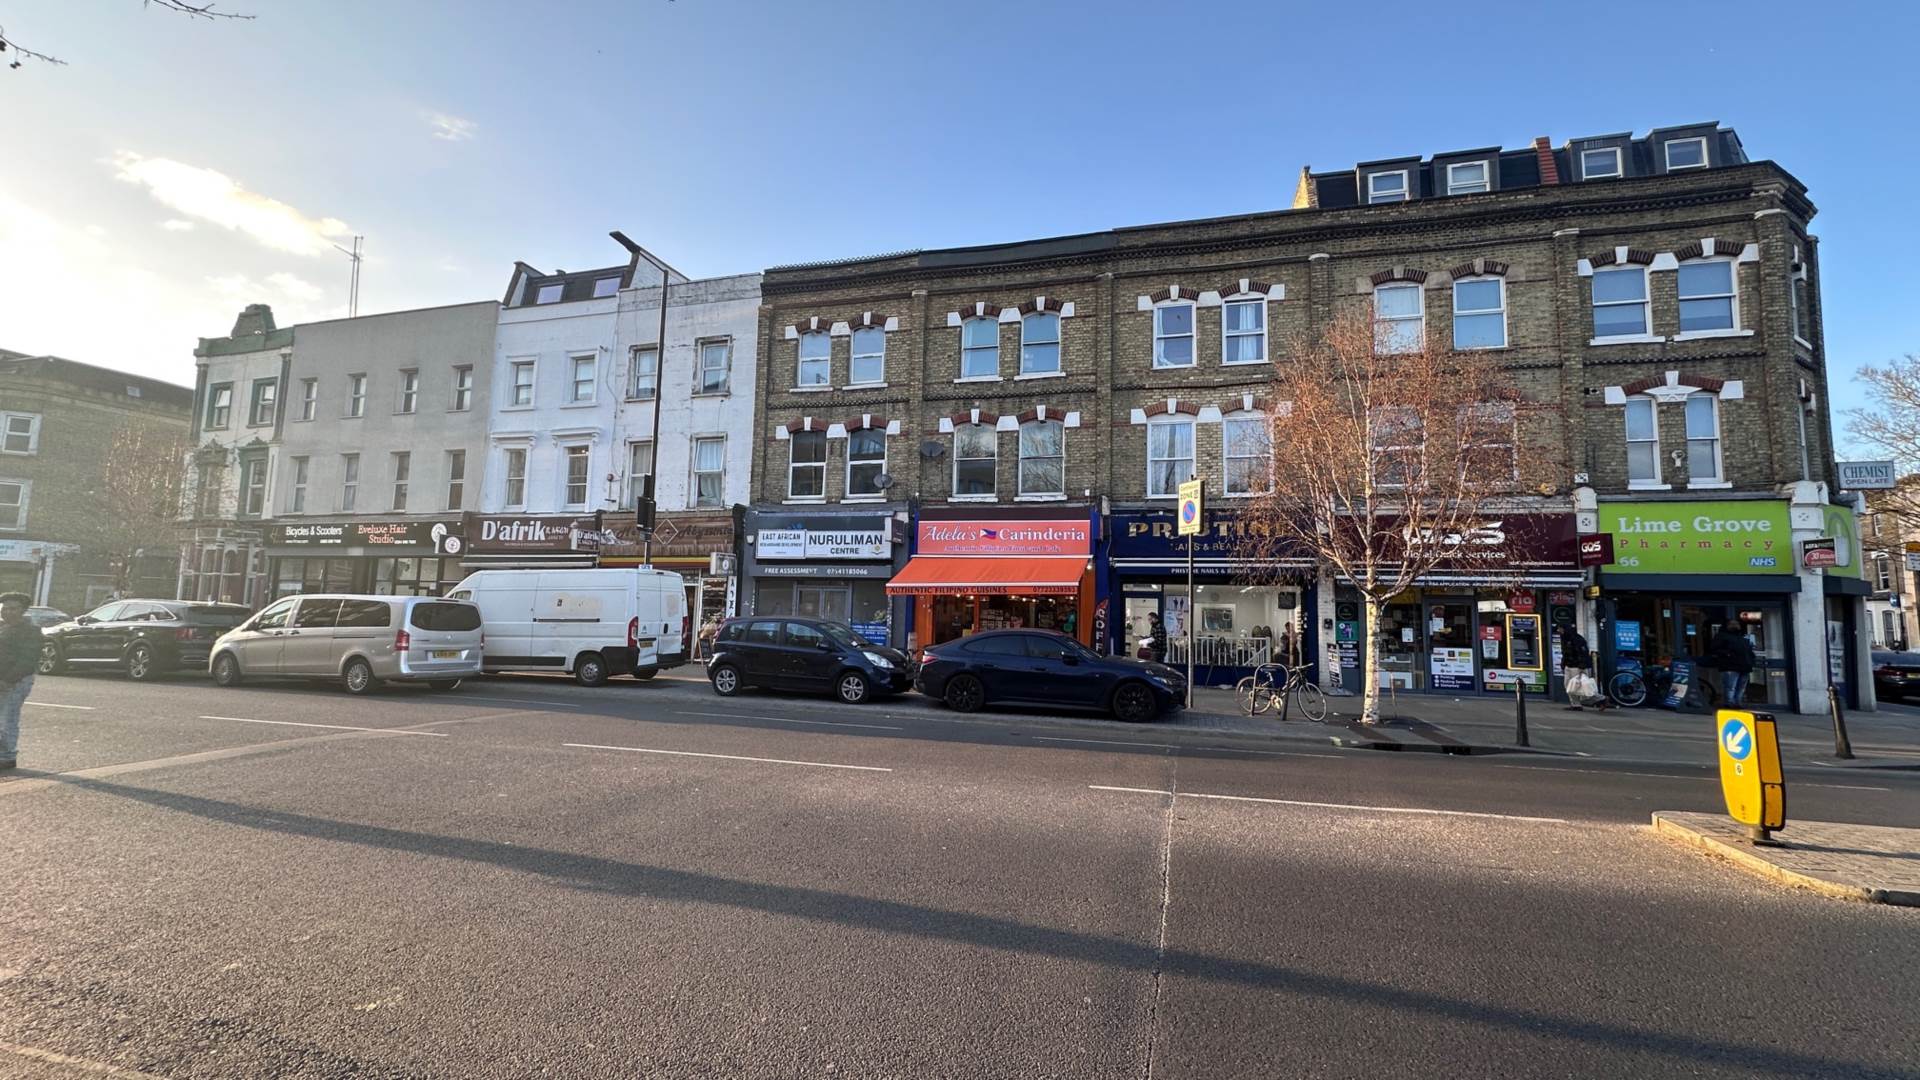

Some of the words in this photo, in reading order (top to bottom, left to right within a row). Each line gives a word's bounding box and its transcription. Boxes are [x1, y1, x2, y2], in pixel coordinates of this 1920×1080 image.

[1844, 466, 1889, 478] CHEMIST
[390, 524, 408, 534] Hair
[1617, 517, 1681, 533] Lime
[1693, 515, 1772, 532] Grove
[286, 526, 309, 538] Bicycles
[310, 525, 316, 536] &
[316, 525, 343, 536] Scooters
[481, 520, 546, 541] D'afrik
[923, 526, 976, 541] Adela's
[999, 528, 1085, 541] Carinderia
[369, 533, 394, 544] Studio
[762, 533, 776, 541] EAST
[778, 533, 801, 541] AFRICAN
[809, 534, 883, 545] NURULIMAN
[1620, 539, 1774, 550] Pharmacy
[830, 547, 860, 555] CENTRE
[1751, 558, 1776, 567] NHS
[889, 586, 932, 594] AUTHENTIC
[935, 586, 969, 594] FILIPINO
